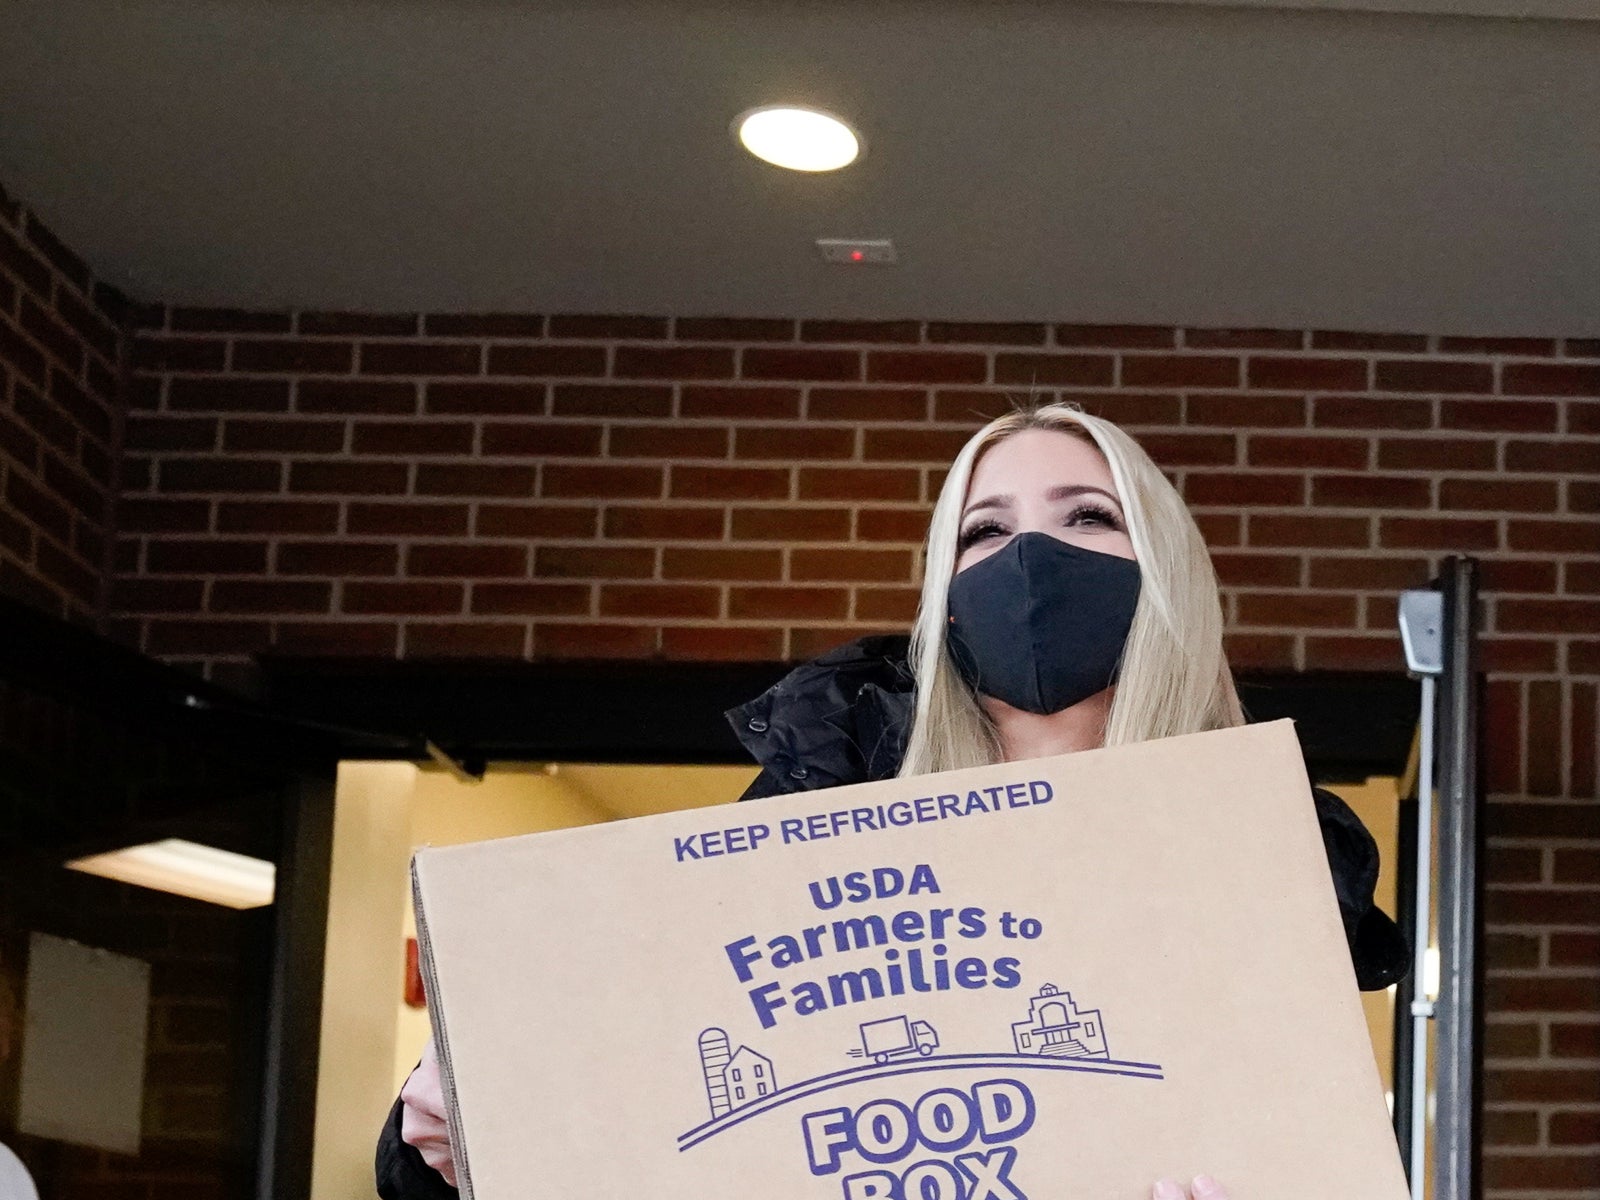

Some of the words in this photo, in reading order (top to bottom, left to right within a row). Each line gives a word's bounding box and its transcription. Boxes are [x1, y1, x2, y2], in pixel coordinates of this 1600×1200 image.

[673, 824, 770, 863] KEEP
[780, 780, 1054, 845] REFRIGERATED
[808, 864, 942, 911] USDA
[724, 904, 987, 984] Farmers
[999, 911, 1043, 940] to
[748, 949, 1022, 1030] Families
[802, 1078, 1036, 1176] FOOD
